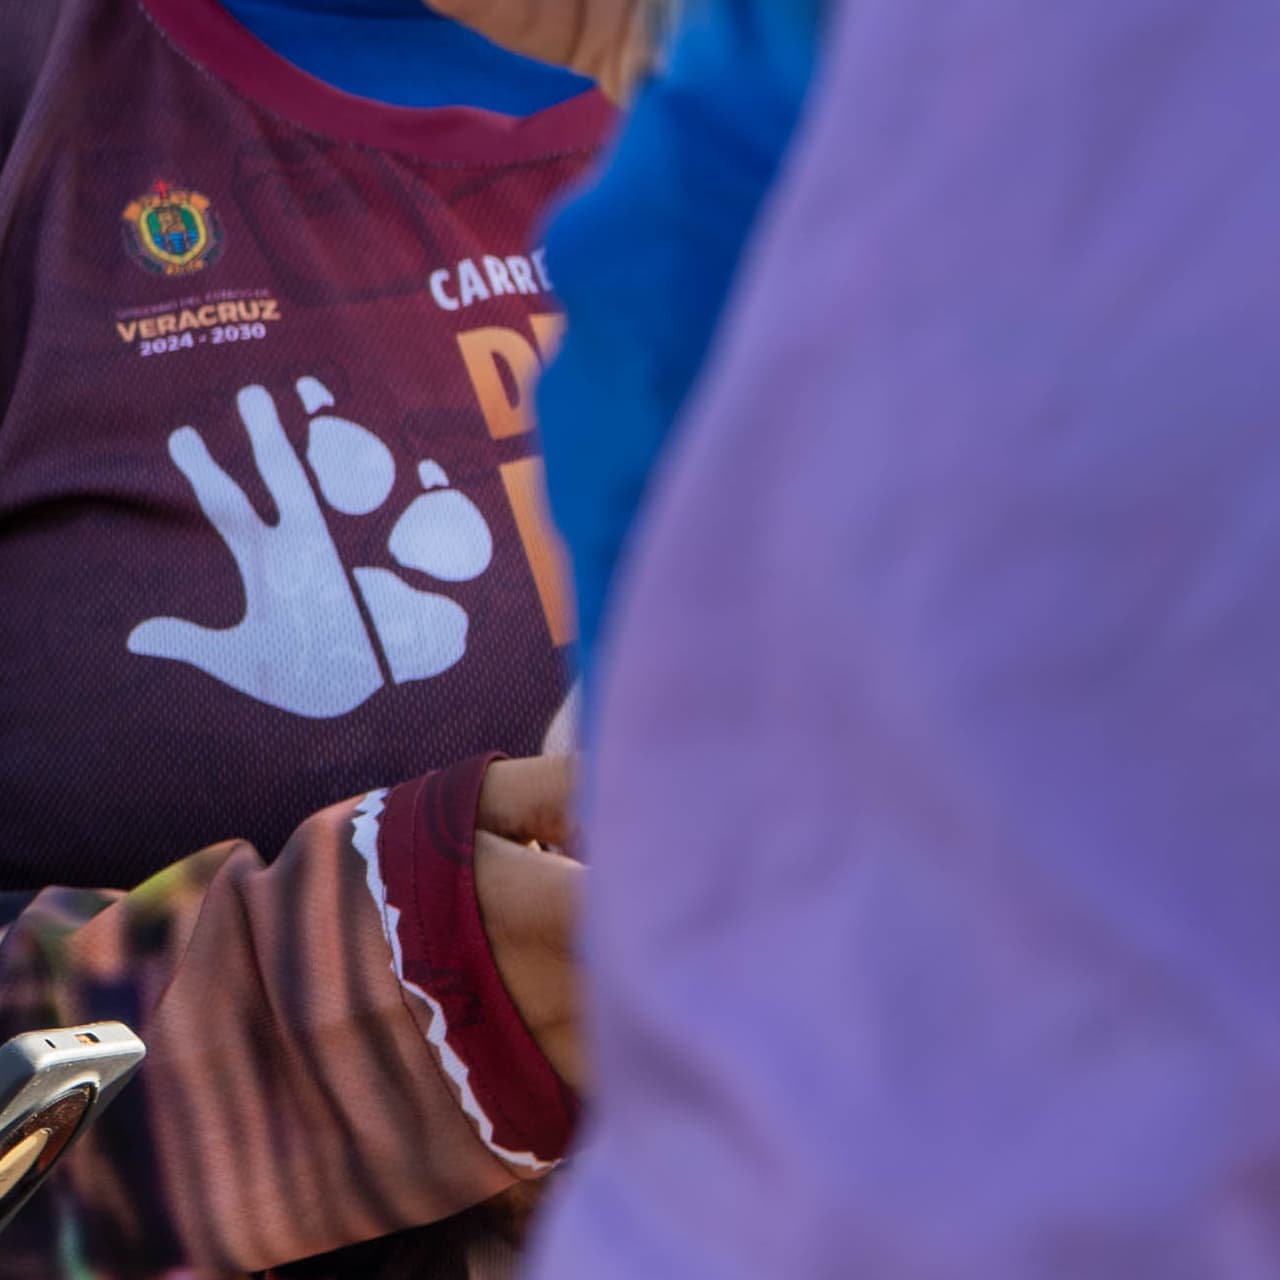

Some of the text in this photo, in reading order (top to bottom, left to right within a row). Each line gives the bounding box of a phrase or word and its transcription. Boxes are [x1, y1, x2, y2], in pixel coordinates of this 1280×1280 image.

[116, 299, 281, 343] VERACRUZ
[140, 332, 194, 357] 2024
[211, 322, 267, 344] 2030
